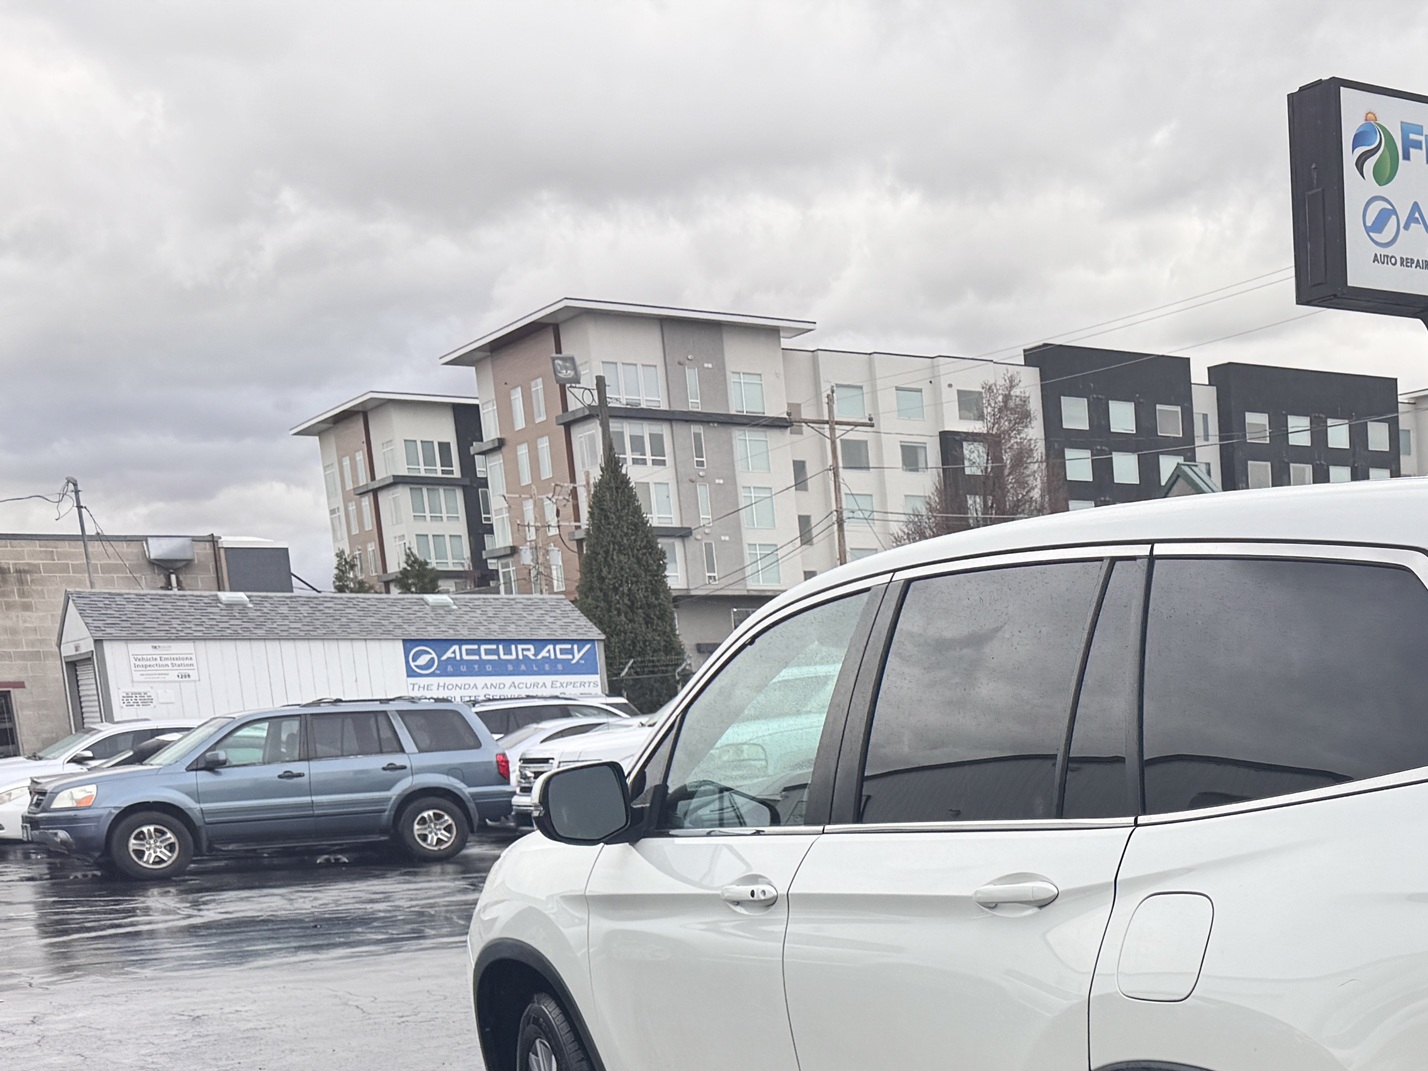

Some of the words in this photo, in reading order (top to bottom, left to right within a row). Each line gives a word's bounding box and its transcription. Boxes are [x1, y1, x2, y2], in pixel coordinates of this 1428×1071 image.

[1372, 253, 1398, 266] AUTO
[440, 643, 592, 664] ACCURACY
[410, 682, 433, 692] THE
[436, 682, 478, 691] HONDA
[506, 681, 548, 690] ACURA
[550, 680, 599, 689] EXPERTS
